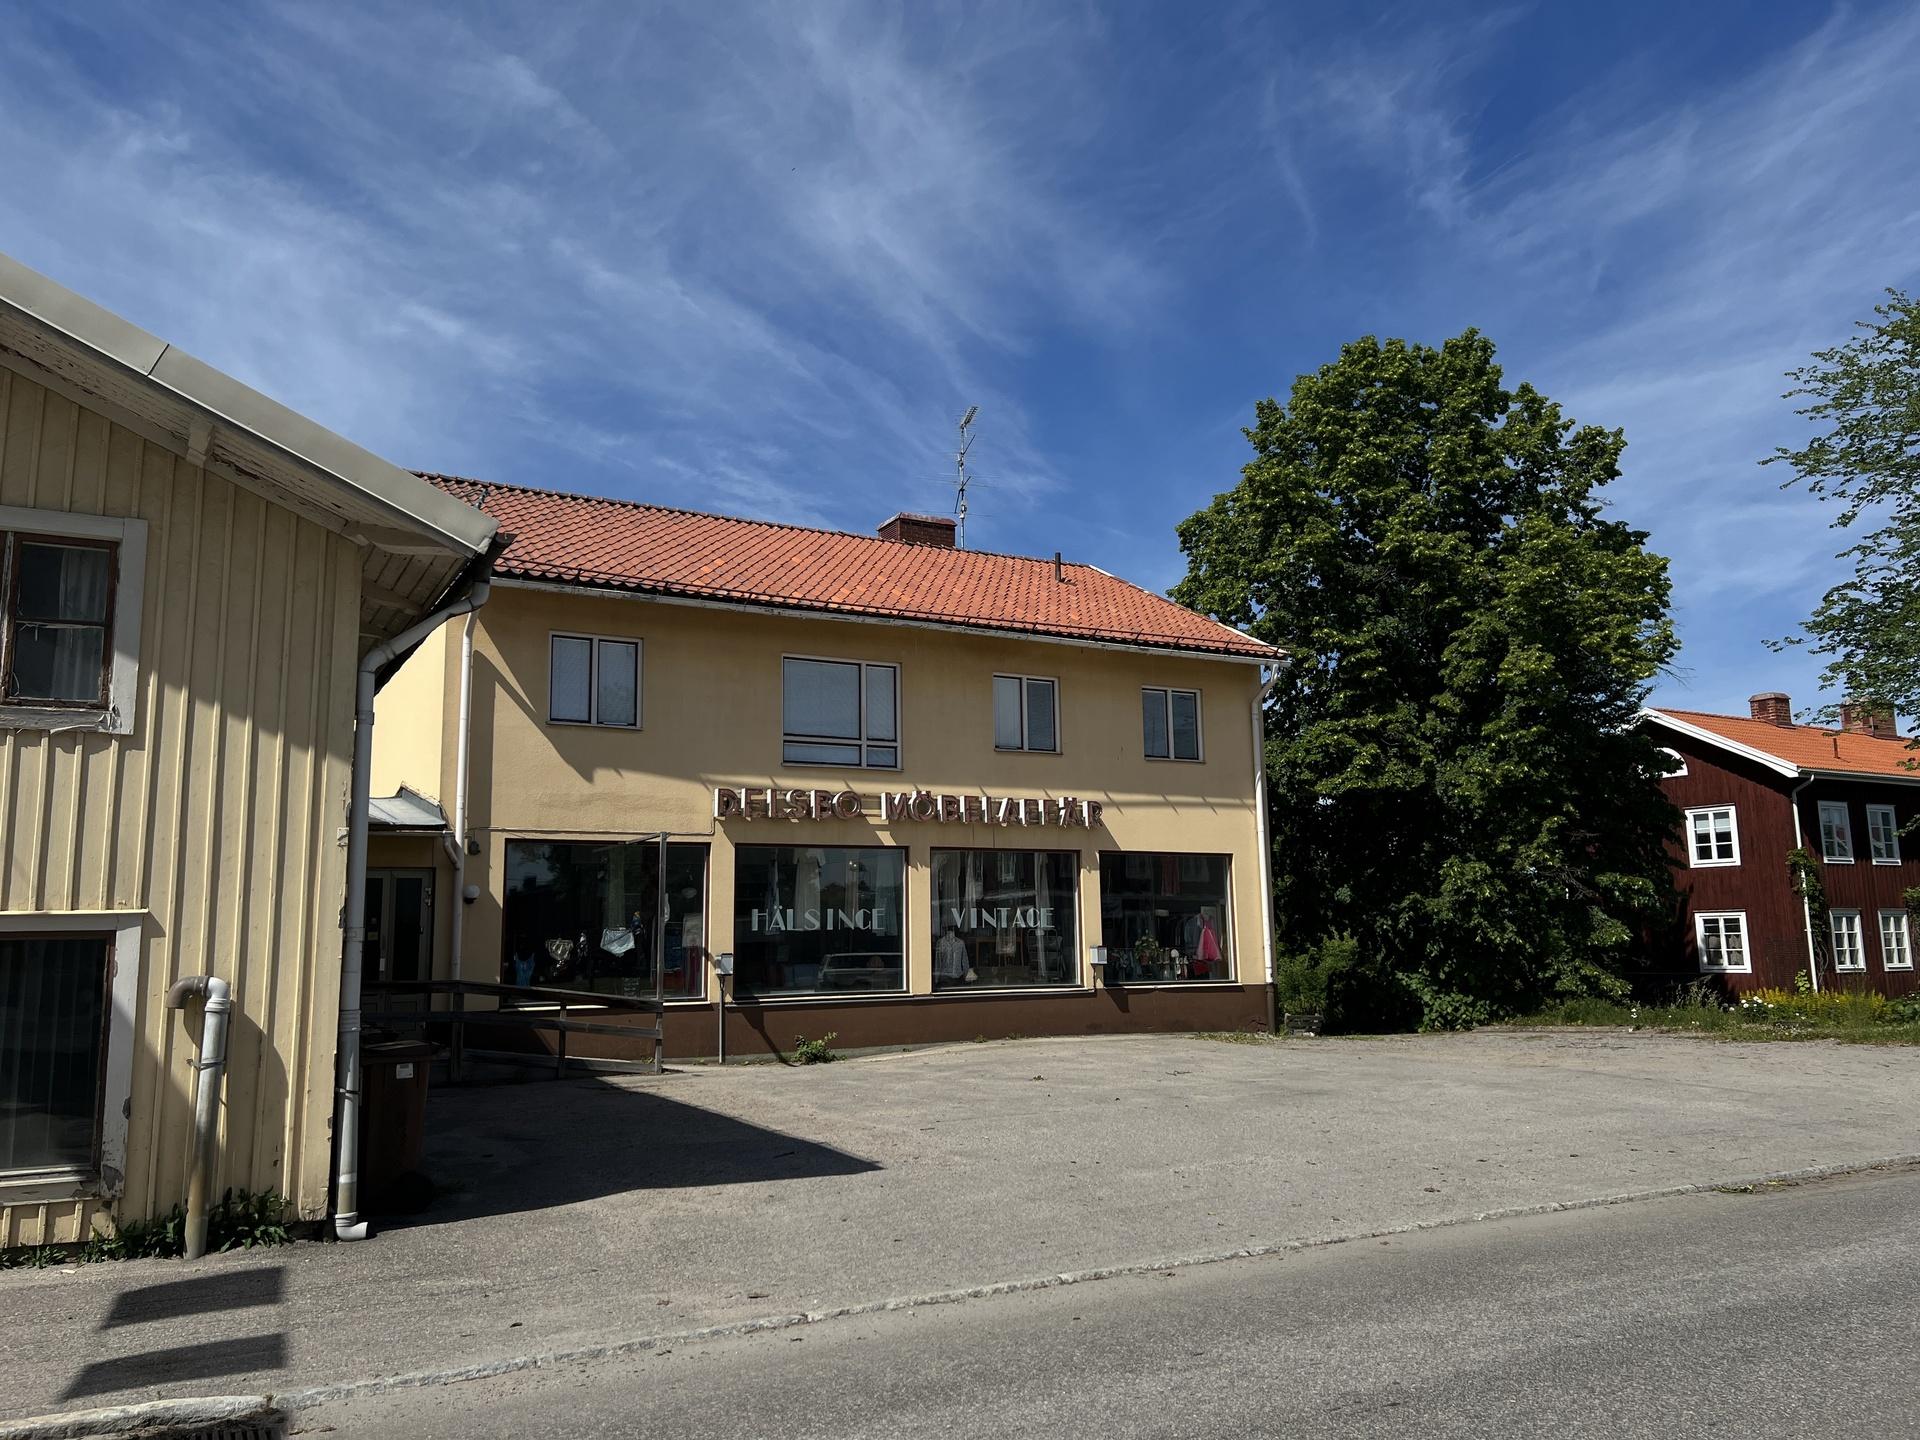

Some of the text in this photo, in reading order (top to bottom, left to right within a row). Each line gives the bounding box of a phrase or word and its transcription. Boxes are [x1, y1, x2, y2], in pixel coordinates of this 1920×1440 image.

[714, 788, 1104, 829] DELSBO MÖBELAFFÄR
[751, 904, 1055, 931] HÄLSINGE VINTAGE
